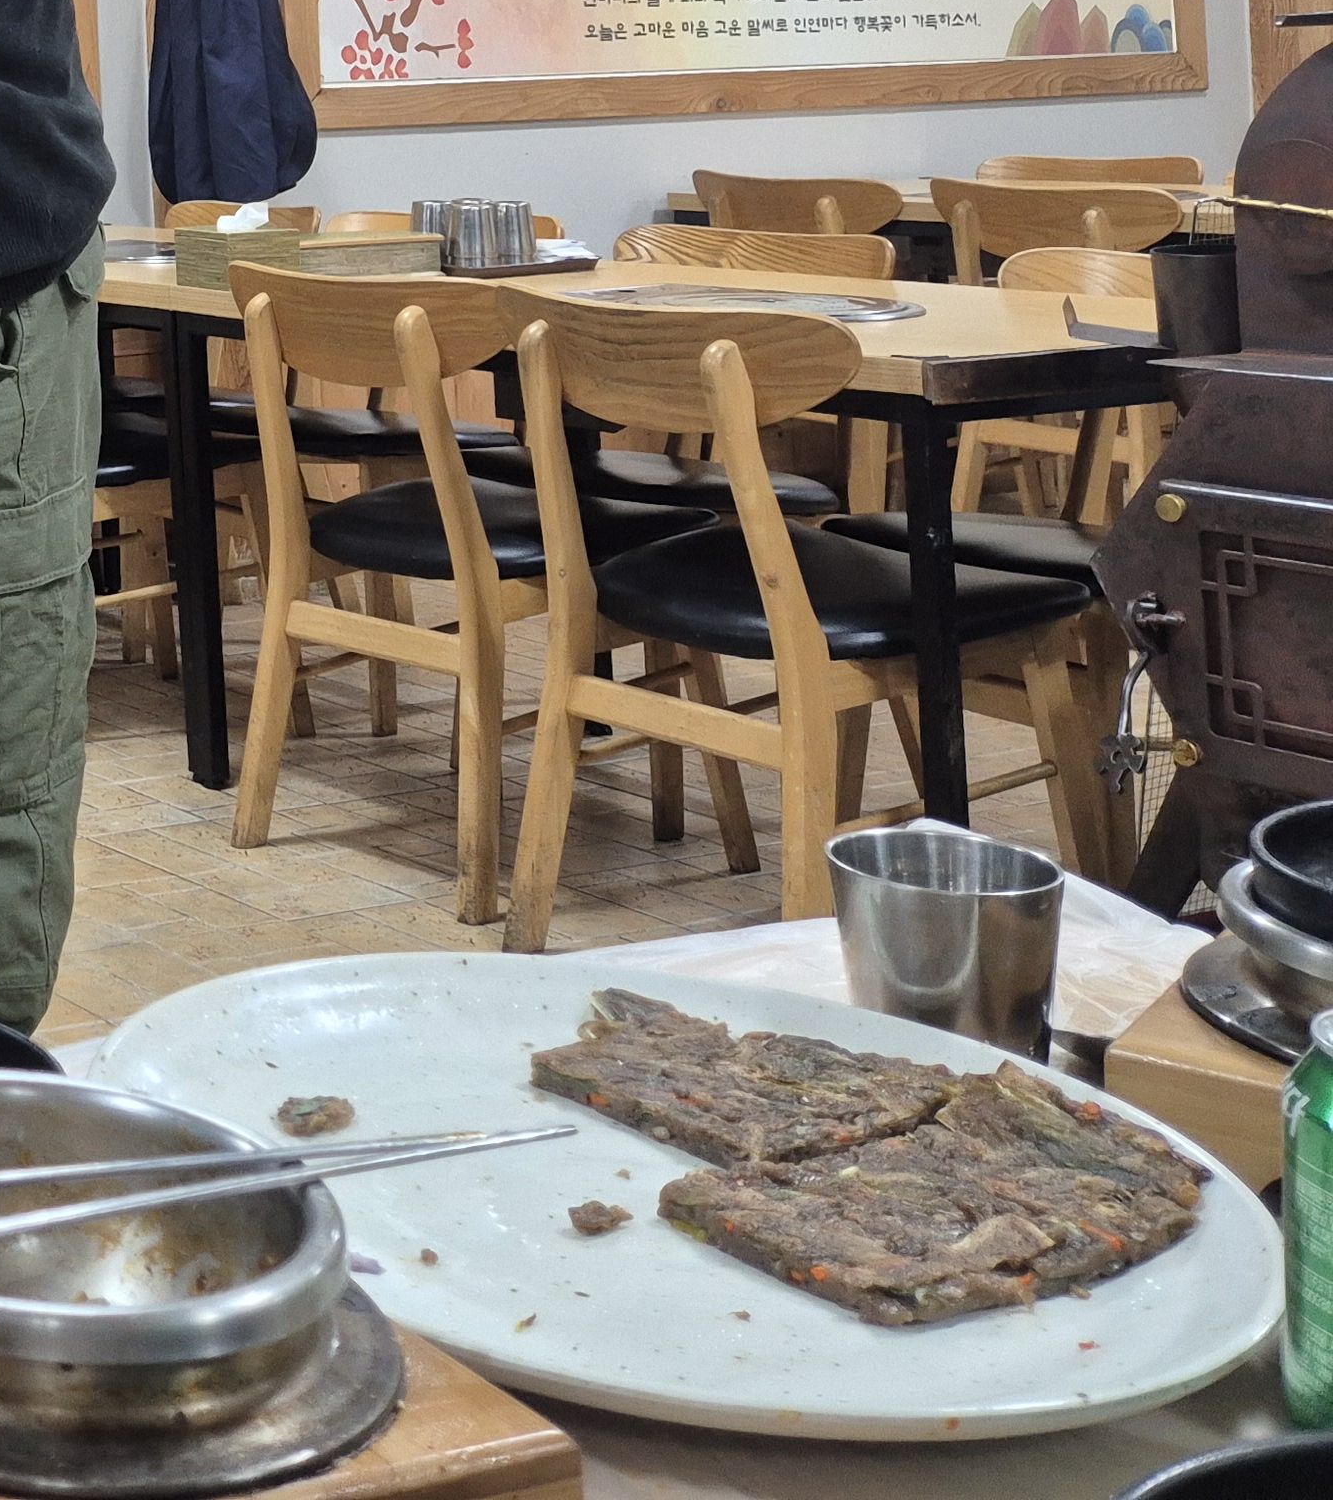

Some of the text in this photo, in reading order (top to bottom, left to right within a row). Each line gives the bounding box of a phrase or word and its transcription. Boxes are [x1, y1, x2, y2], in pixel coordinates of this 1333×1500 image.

[583, 22, 628, 42] 오늘은
[632, 20, 676, 39] 고마운
[681, 19, 710, 39] 마음
[713, 19, 742, 37] 고운
[747, 18, 789, 37] 말씨로
[793, 16, 848, 34] 인연마다
[852, 14, 907, 34] 행복꽃이
